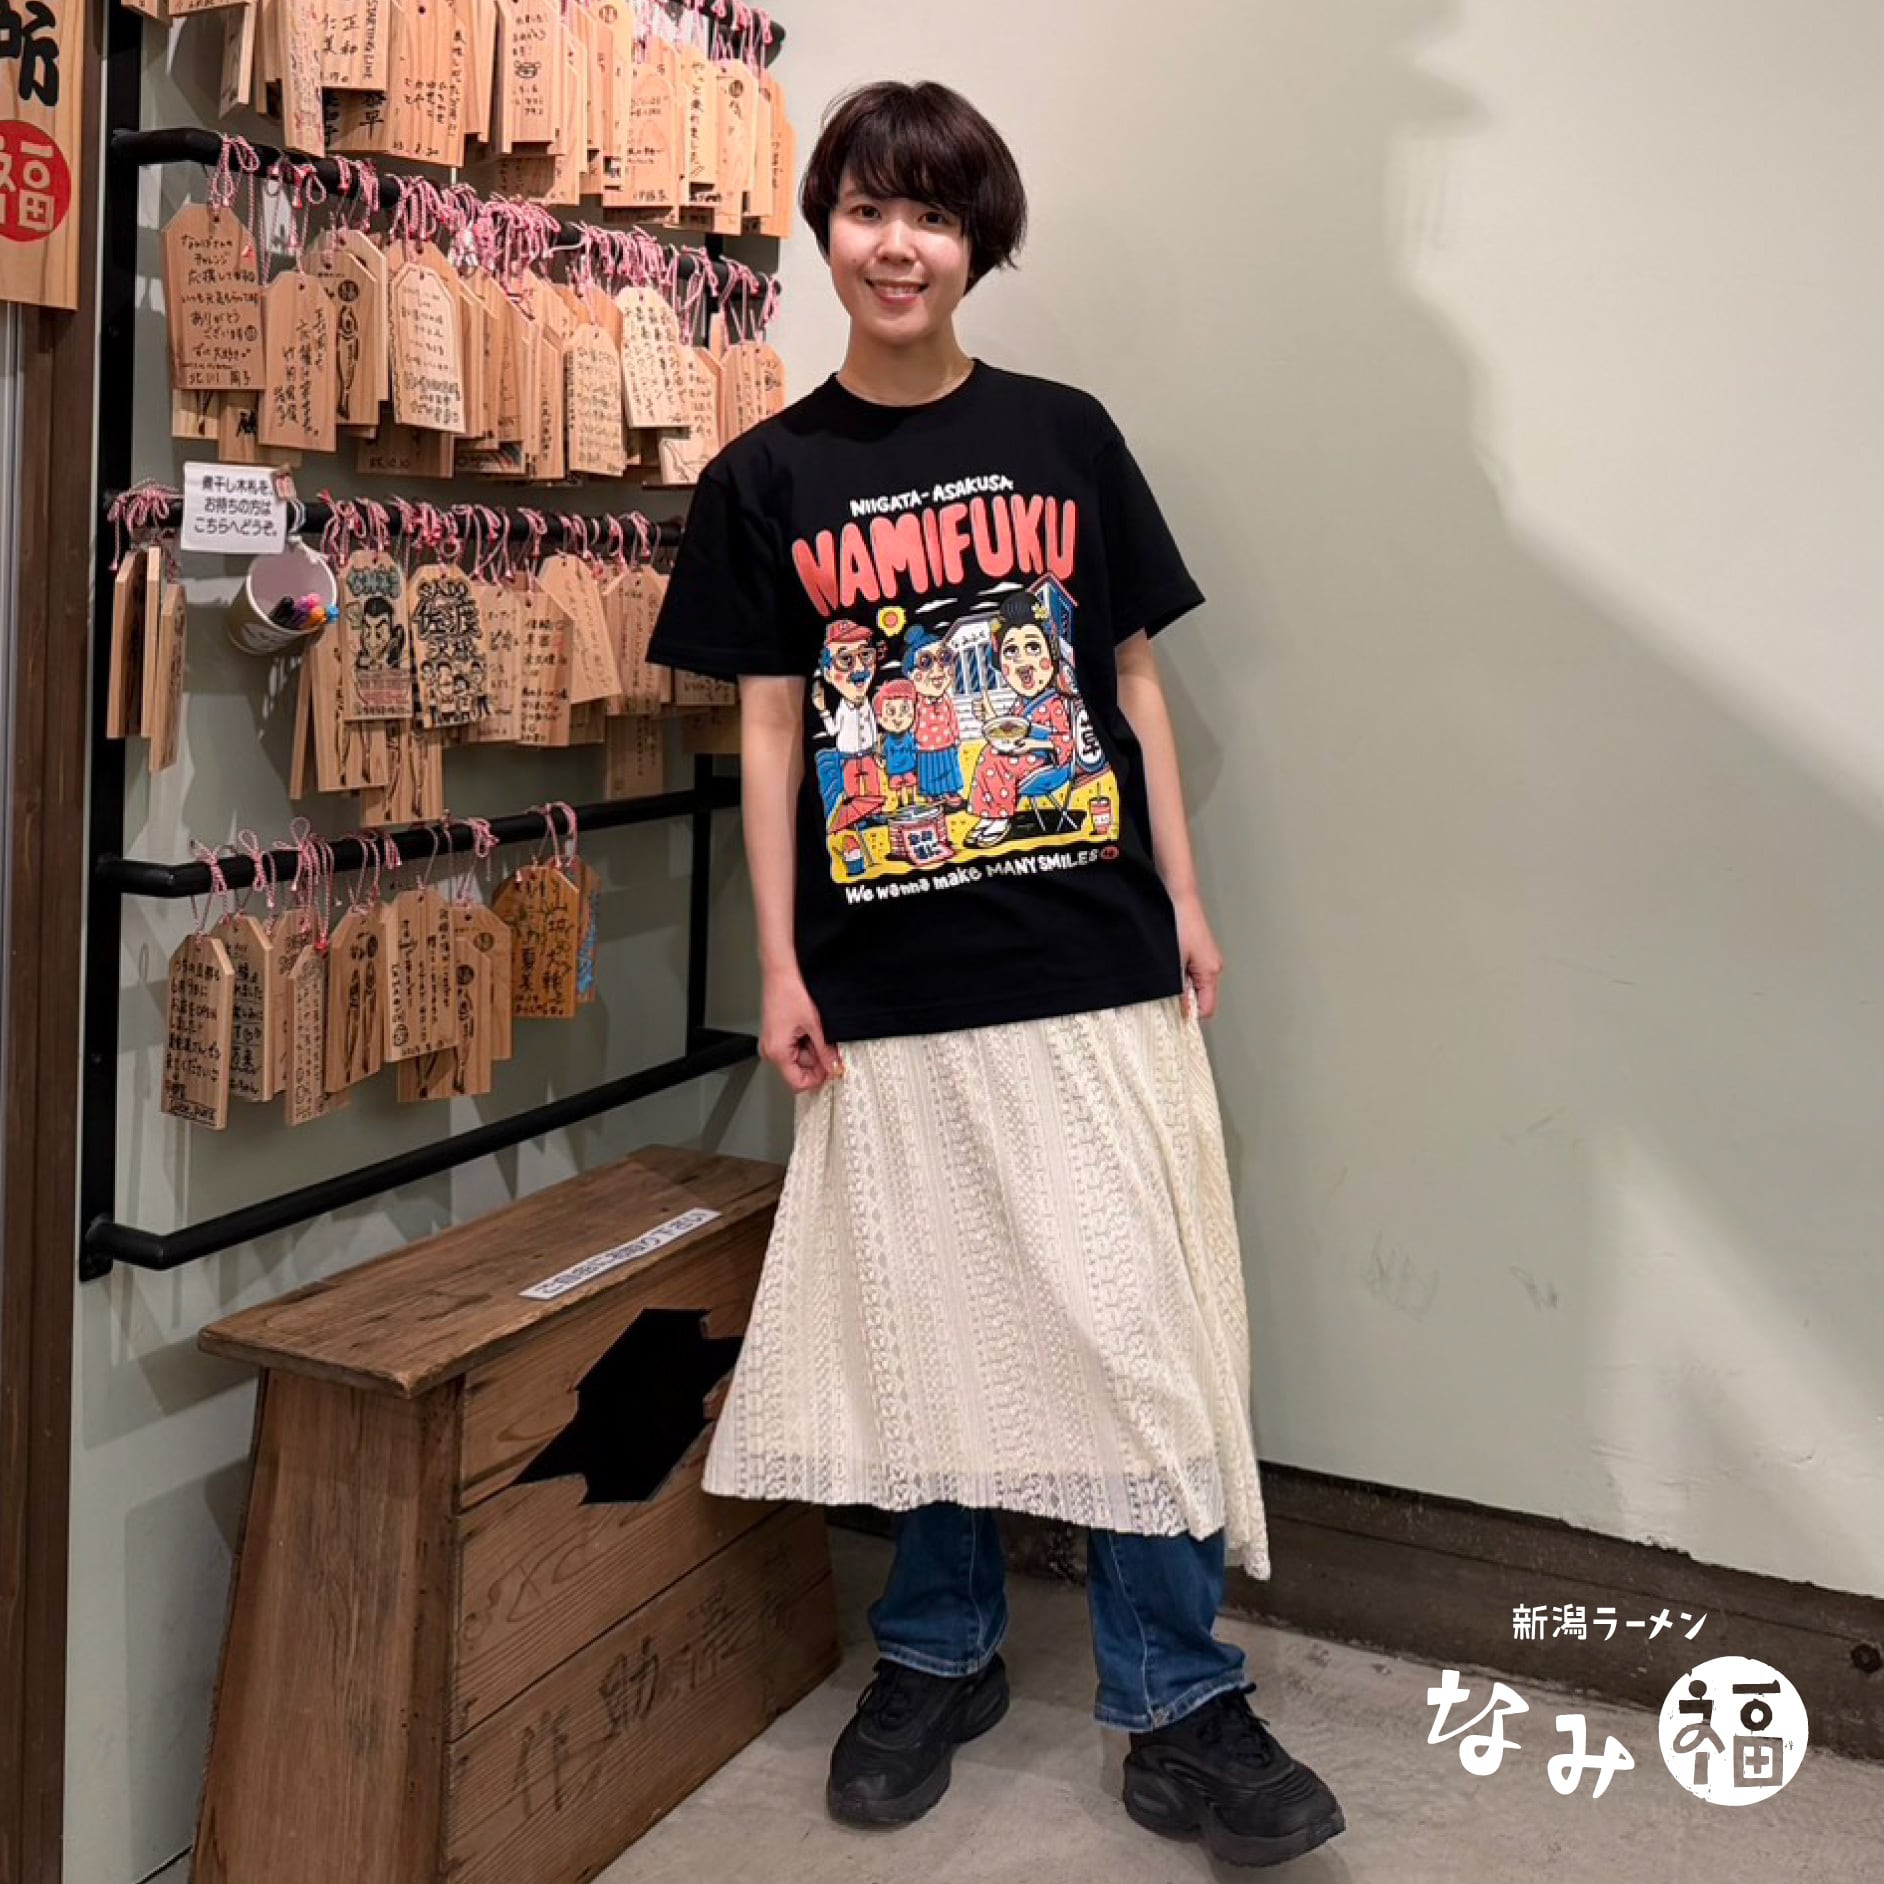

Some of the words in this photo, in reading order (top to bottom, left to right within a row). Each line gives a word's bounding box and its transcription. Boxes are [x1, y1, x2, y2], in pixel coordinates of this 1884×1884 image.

[204, 496, 272, 516] お持ちの方は
[194, 516, 278, 537] こちらへどうぞ。
[791, 495, 1077, 617] NAMIFUKU
[845, 884, 875, 905] We
[876, 877, 931, 901] wanna
[933, 866, 983, 891] make
[985, 855, 1038, 878] MANY
[1037, 848, 1100, 872] SMILES
